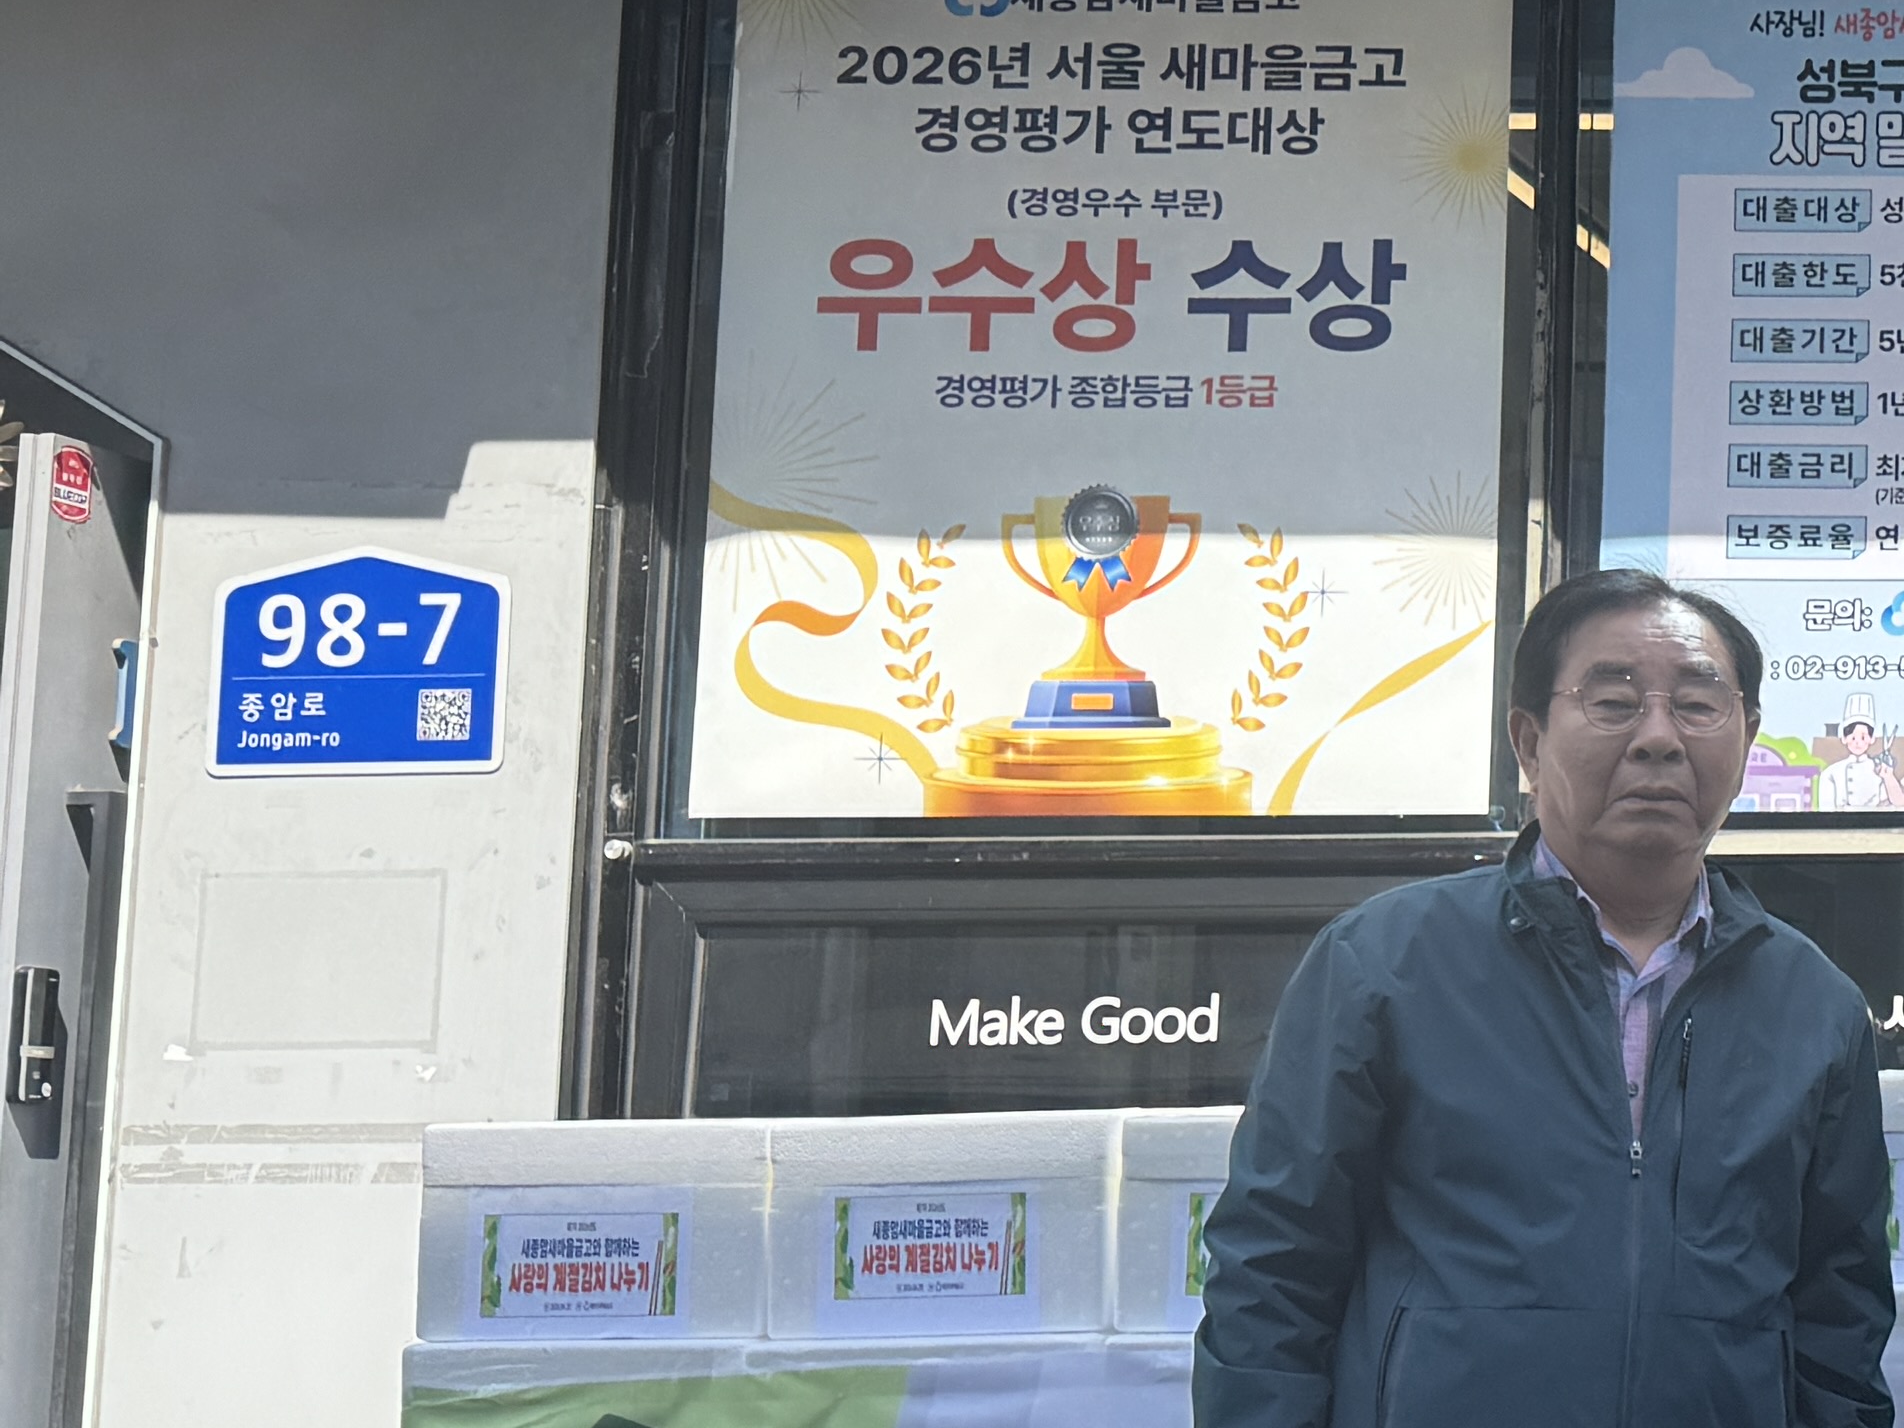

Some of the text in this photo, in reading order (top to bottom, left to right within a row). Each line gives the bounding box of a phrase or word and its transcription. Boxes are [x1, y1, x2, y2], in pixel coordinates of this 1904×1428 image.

[1750, 9, 1824, 38] 사장님!
[837, 42, 1406, 91] 2026년 서울 새마을금고
[915, 105, 1325, 155] 경영평가 연도대상
[1770, 110, 1867, 168] 지역
[1008, 187, 1222, 220] (경영우수 부문)
[1743, 196, 1859, 223] 대출대상
[1742, 261, 1858, 288] 대출한도
[817, 238, 1407, 352] 우수상 수상
[1740, 326, 1857, 354] 대출기간
[936, 374, 1278, 408] 경영평가 종합등급 1등급
[1738, 389, 1854, 416] 상환방법
[1737, 452, 1853, 479] 대출금리
[1735, 523, 1854, 550] 보증료율
[1875, 524, 1898, 550] 연
[259, 593, 461, 668] 98-7
[1803, 598, 1873, 632] 문의:
[239, 693, 326, 722] 종암로
[237, 730, 340, 750] Jongam-ro
[930, 993, 1219, 1046] Make Good
